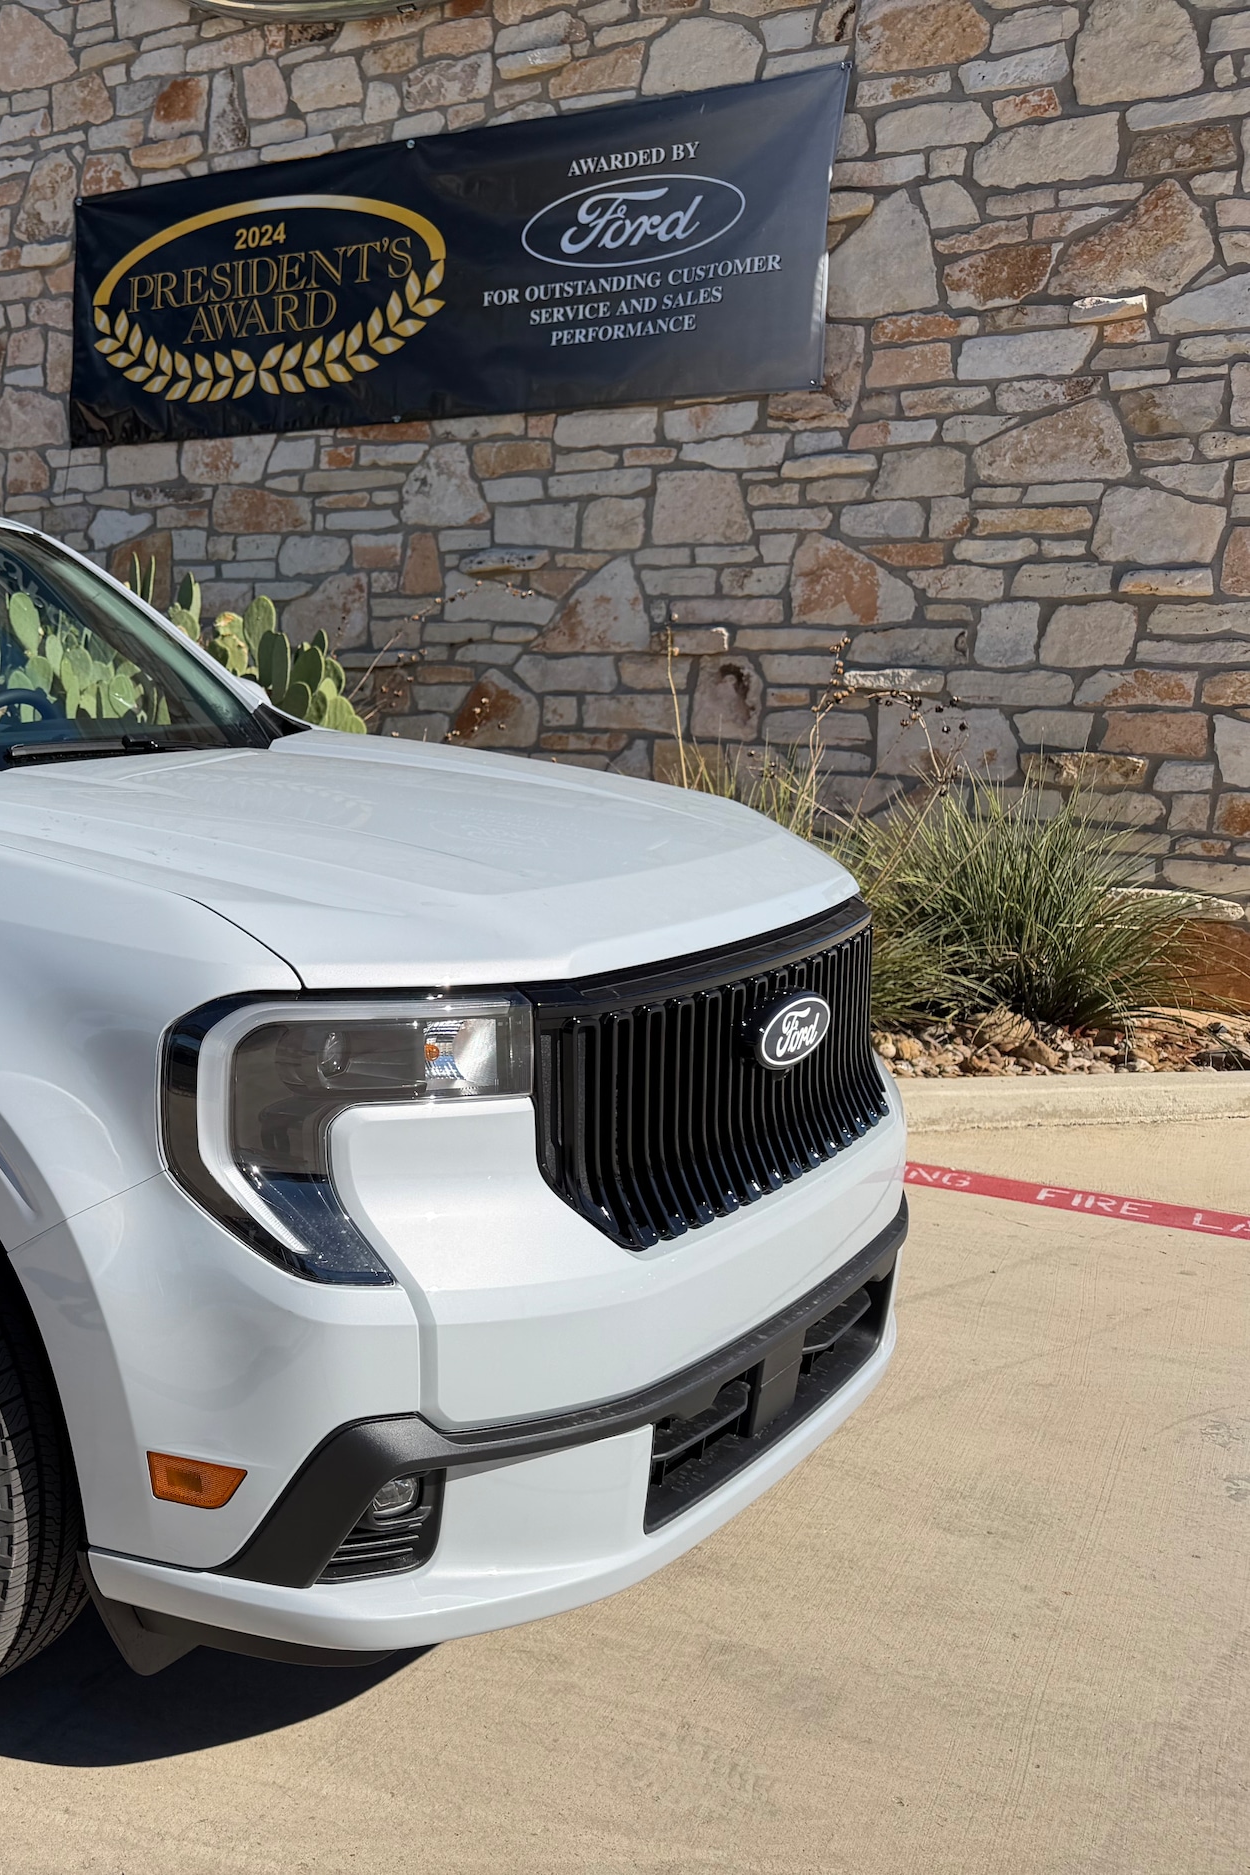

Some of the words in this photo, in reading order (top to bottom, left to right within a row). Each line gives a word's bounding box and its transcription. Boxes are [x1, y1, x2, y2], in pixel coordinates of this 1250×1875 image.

[567, 147, 666, 177] AWARDED
[671, 141, 700, 161] BY
[234, 222, 286, 250] 2024
[560, 187, 703, 254] Ford
[128, 237, 414, 313] PRESIDENT'S
[482, 288, 520, 307] FOR
[524, 271, 662, 302] OUTSTANDING
[667, 254, 782, 286] CUSTOMER
[183, 290, 337, 344] AWARD
[530, 301, 611, 326] SERVICE
[616, 297, 658, 316] AND
[662, 286, 724, 311] SALES
[550, 314, 697, 347] PERFORMANCE
[776, 1007, 820, 1057] Ford
[1036, 1187, 1153, 1219] FIRE
